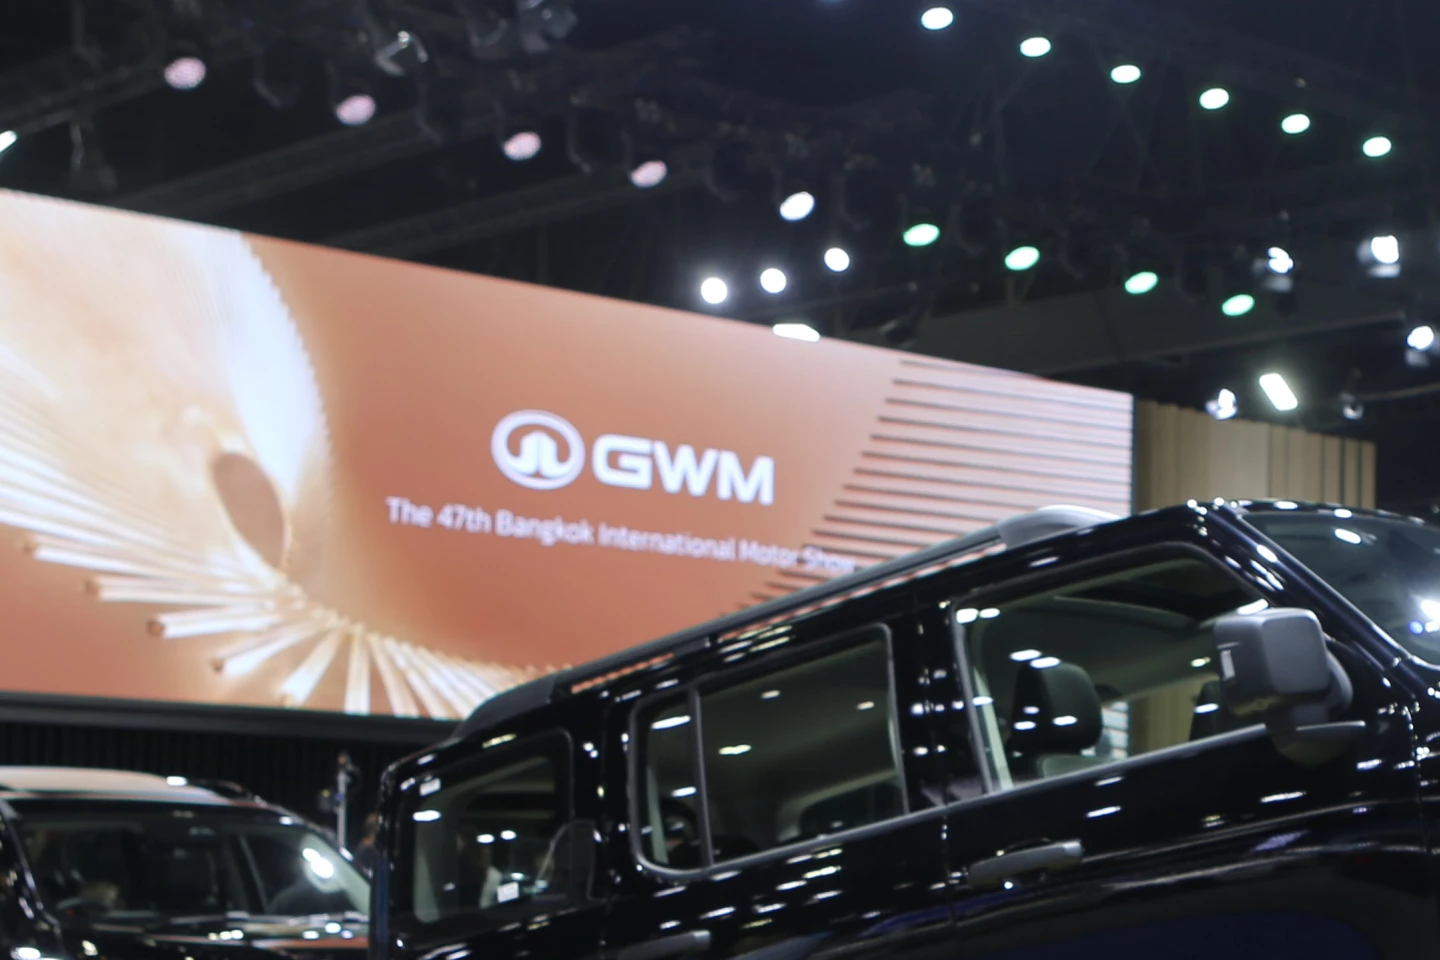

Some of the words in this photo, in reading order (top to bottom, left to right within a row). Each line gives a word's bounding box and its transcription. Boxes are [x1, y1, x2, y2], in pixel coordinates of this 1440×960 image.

[592, 433, 774, 506] GWM
[387, 496, 433, 528] The
[436, 503, 492, 533] 47th
[495, 509, 594, 546] Bangkok
[599, 522, 736, 561] International
[739, 539, 797, 568] Motor
[803, 546, 855, 574] Show
